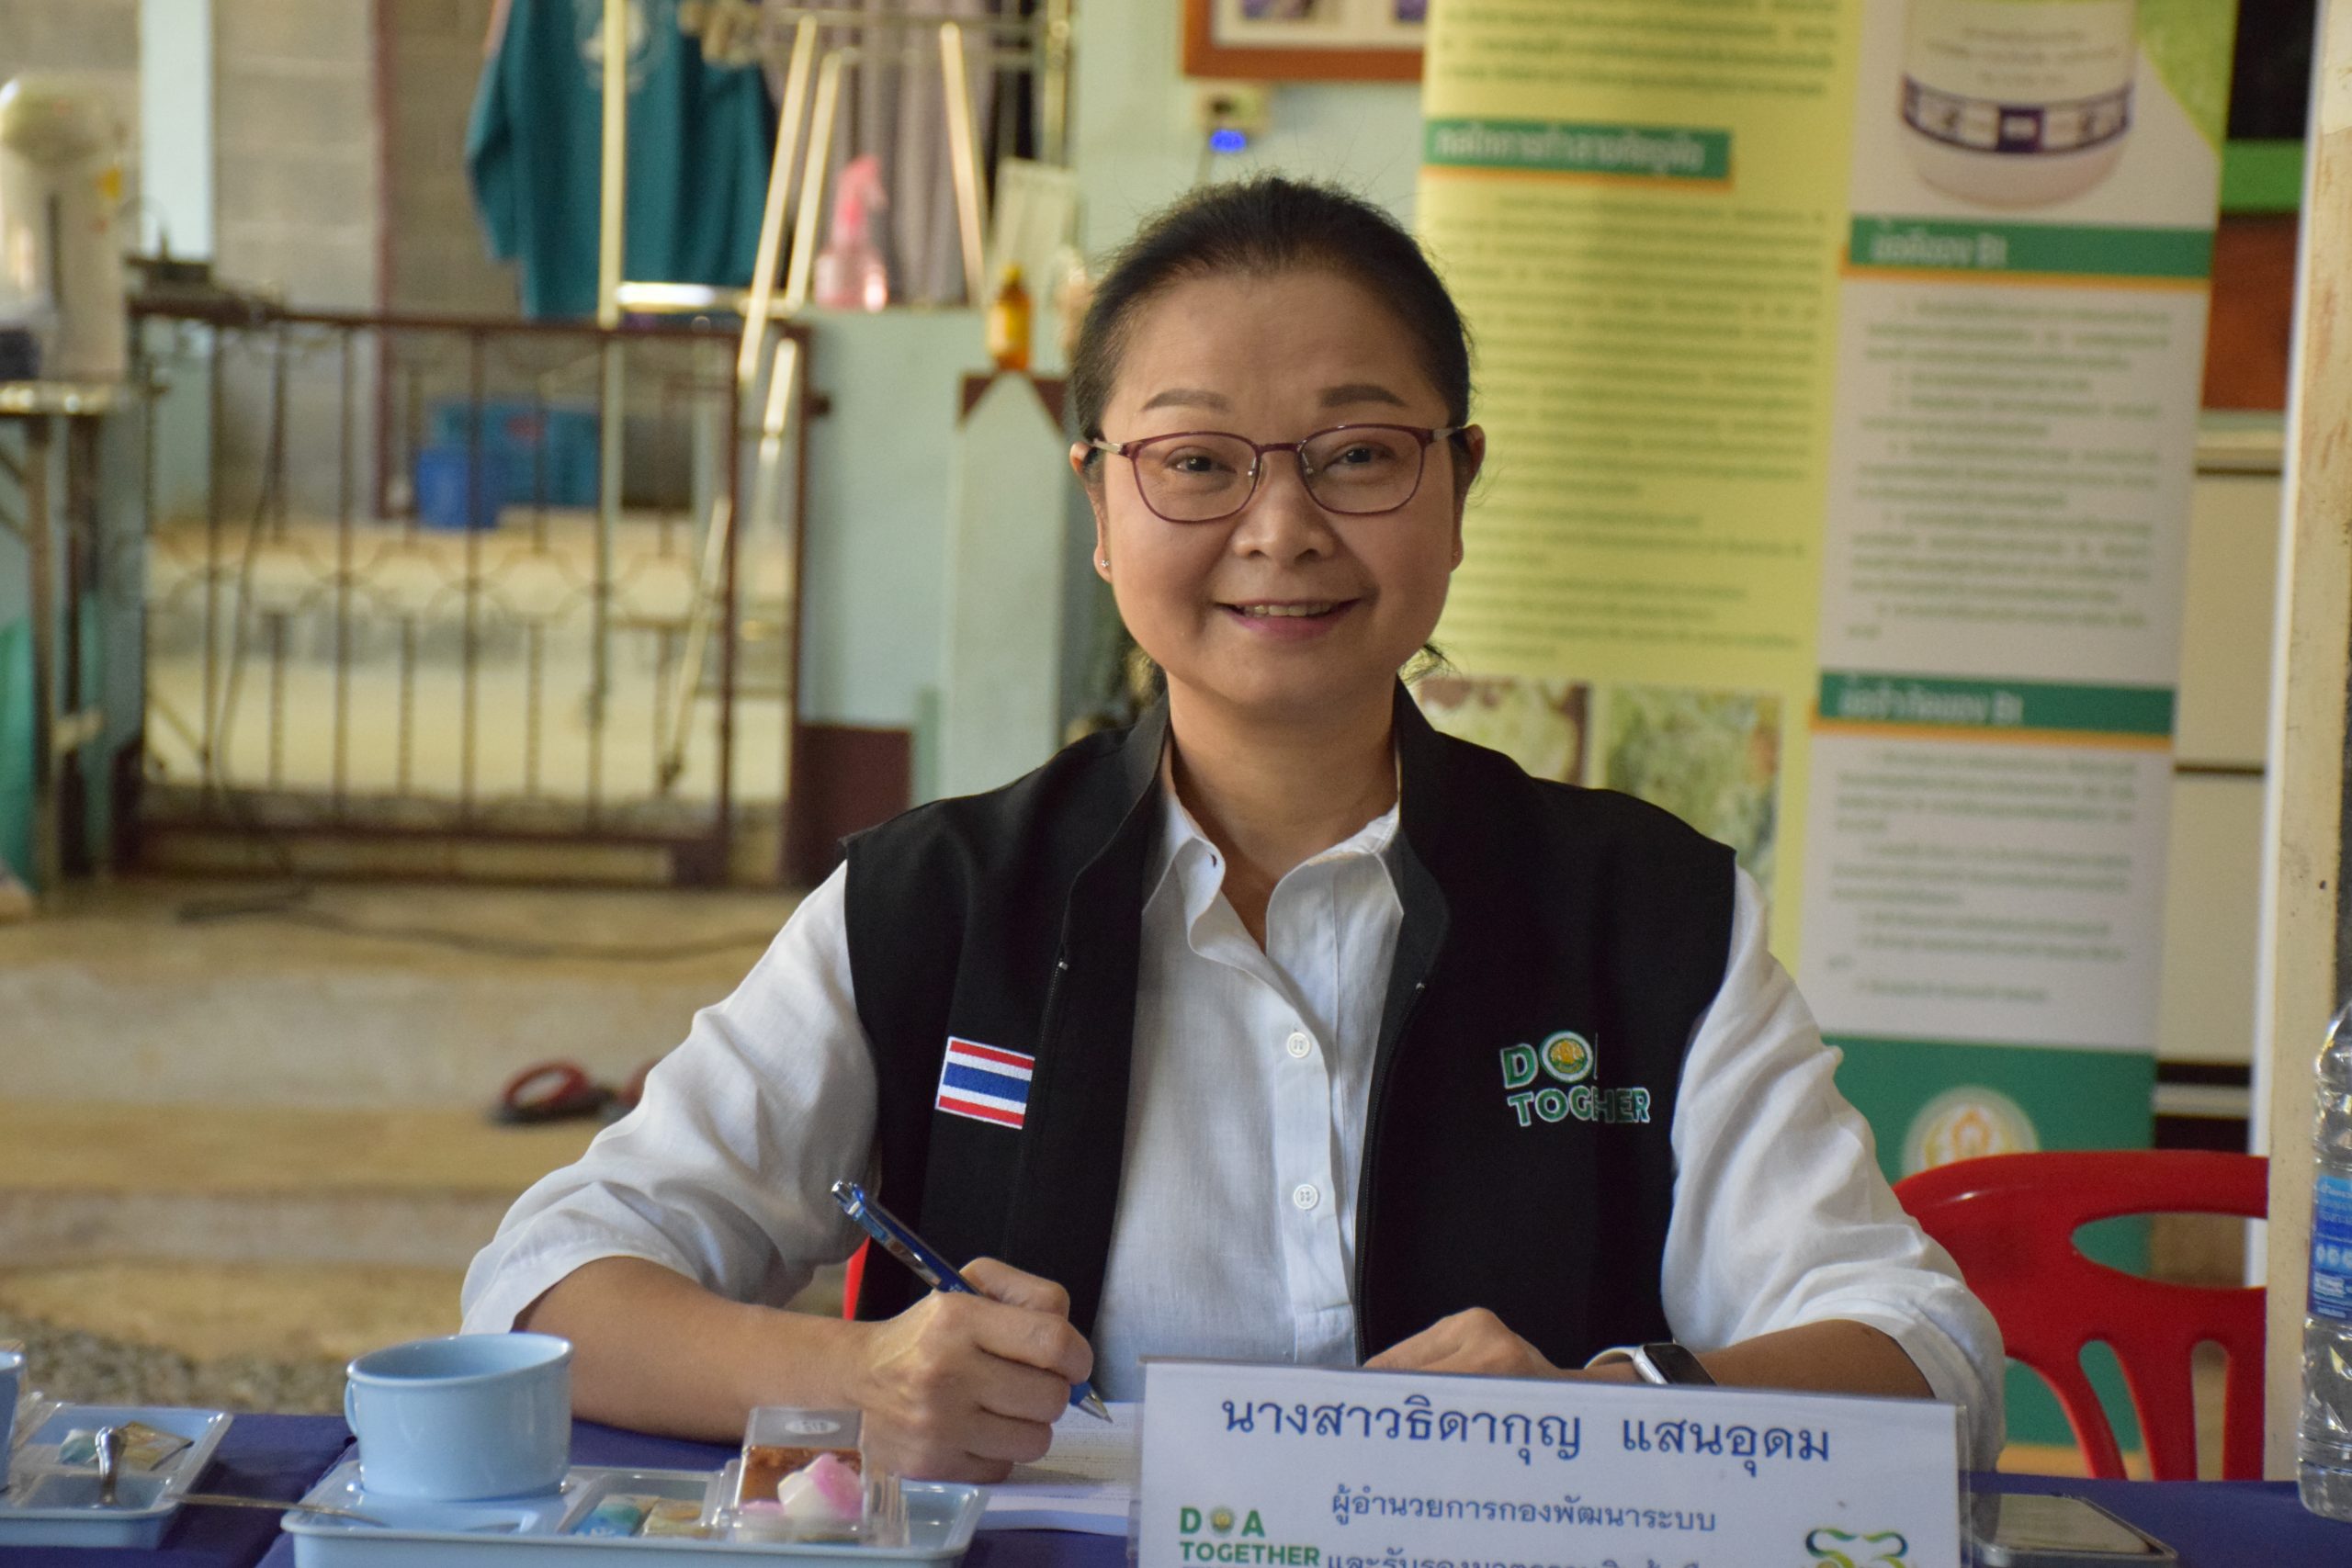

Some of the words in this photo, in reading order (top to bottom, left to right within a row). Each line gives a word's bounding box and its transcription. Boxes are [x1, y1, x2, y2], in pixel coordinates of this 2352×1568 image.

[1221, 1393, 1581, 1466] นางสาวธิดากุญ
[1622, 1418, 1829, 1478] แสนอุดม
[1330, 1482, 1717, 1533] ผู้อำนวยการกองพัฒนาระบบ
[1179, 1540, 1321, 1566] TOGETHER
